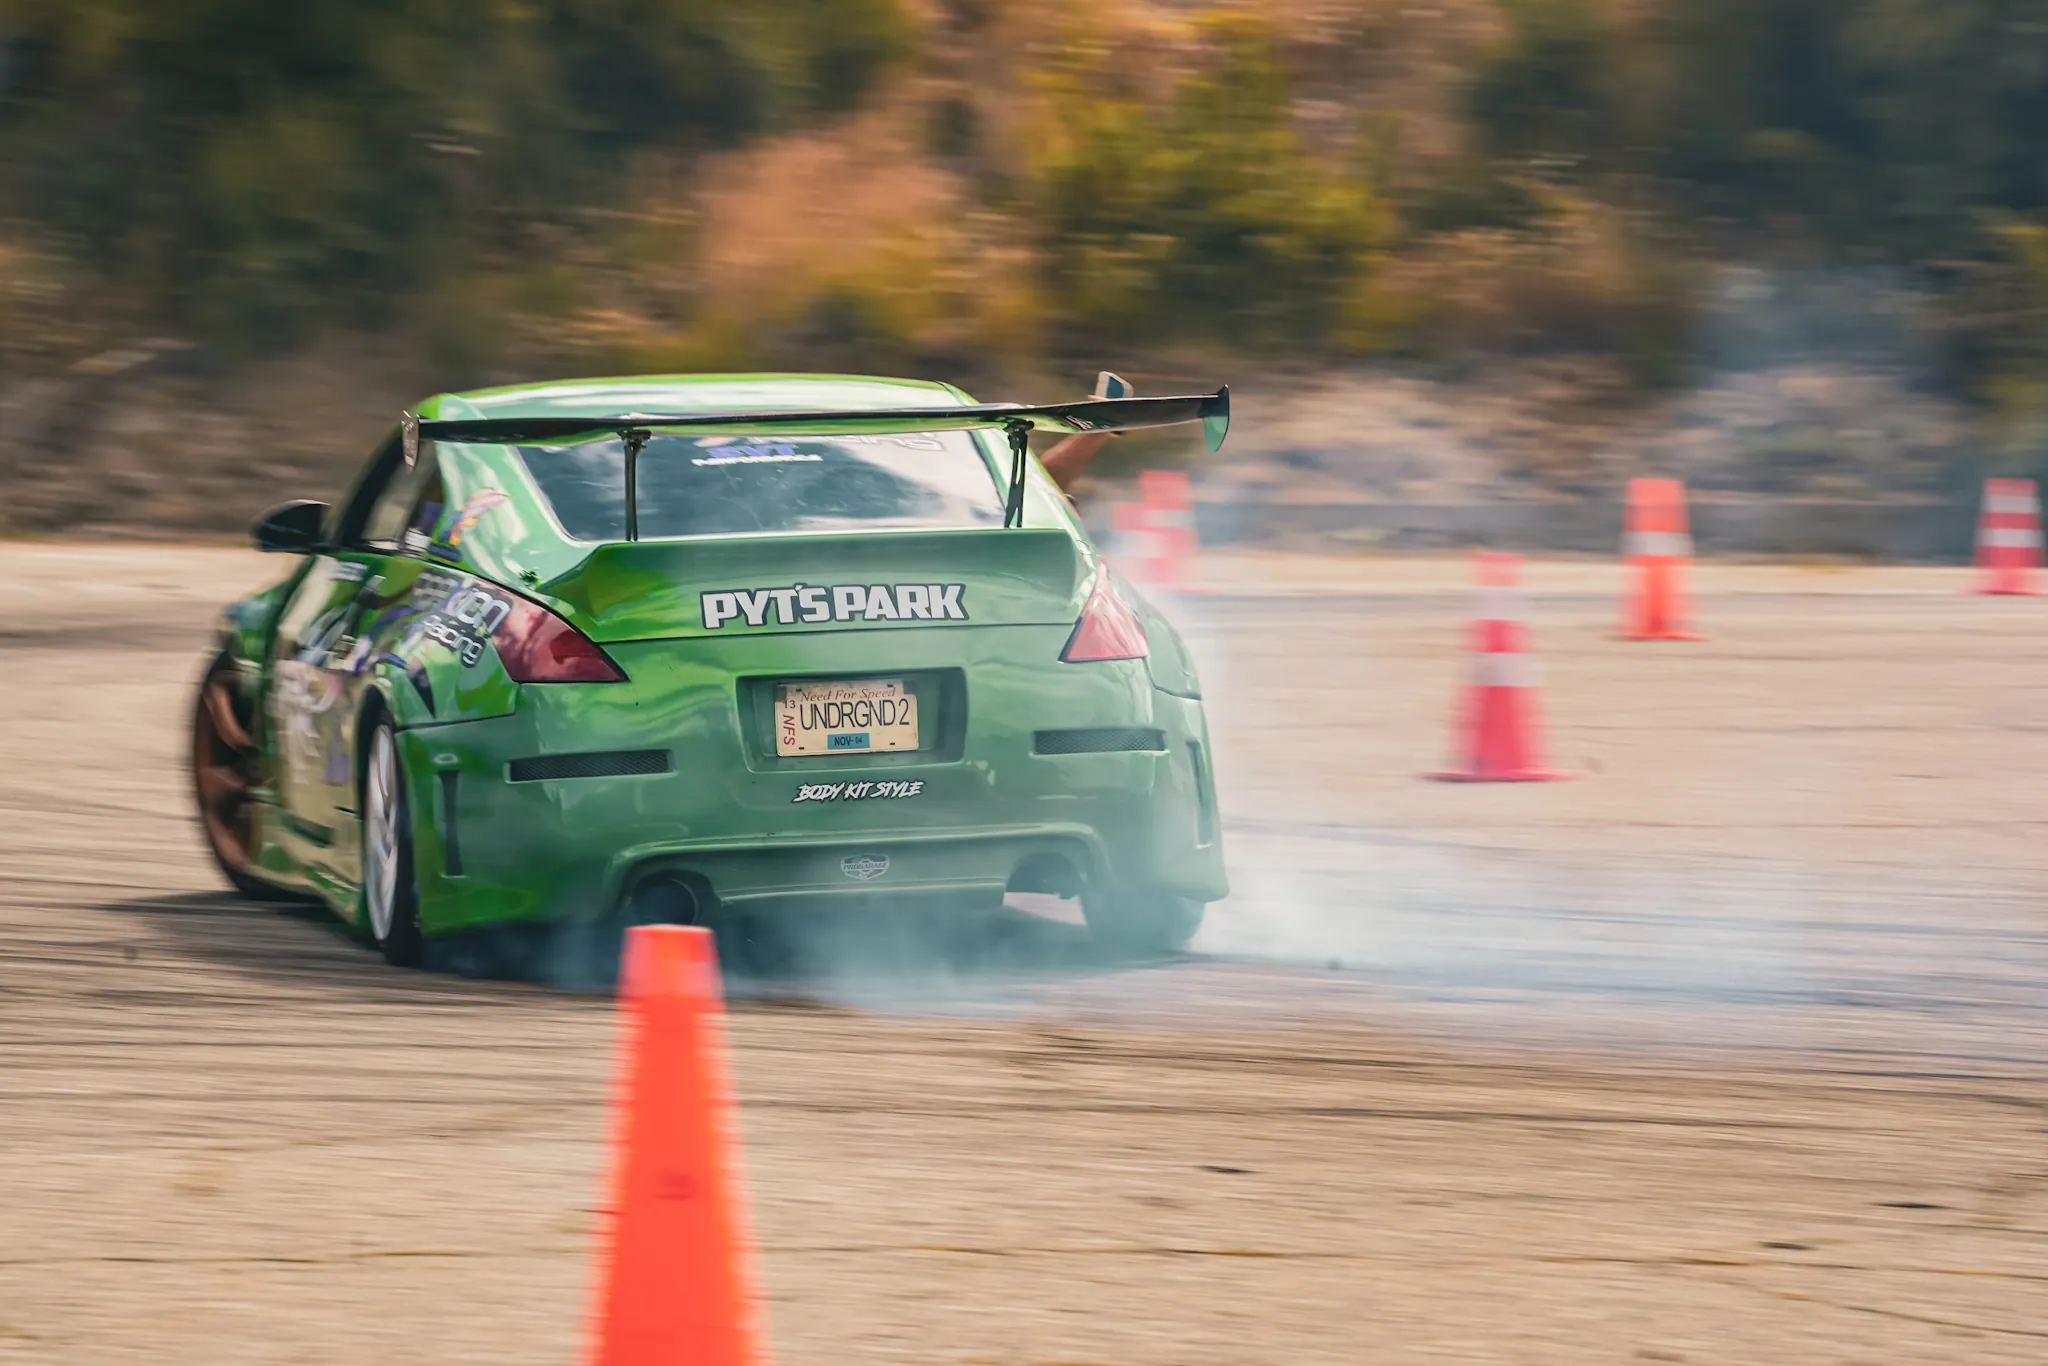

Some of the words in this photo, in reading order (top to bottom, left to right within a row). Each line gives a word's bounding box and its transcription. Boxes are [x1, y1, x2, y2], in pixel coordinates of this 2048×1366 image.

[800, 691, 832, 703] Need
[834, 689, 857, 701] For
[859, 687, 897, 701] Speed
[783, 714, 796, 746] NFS
[793, 782, 845, 802] BODY
[844, 781, 875, 799] KIT
[870, 780, 924, 799] STYLE
